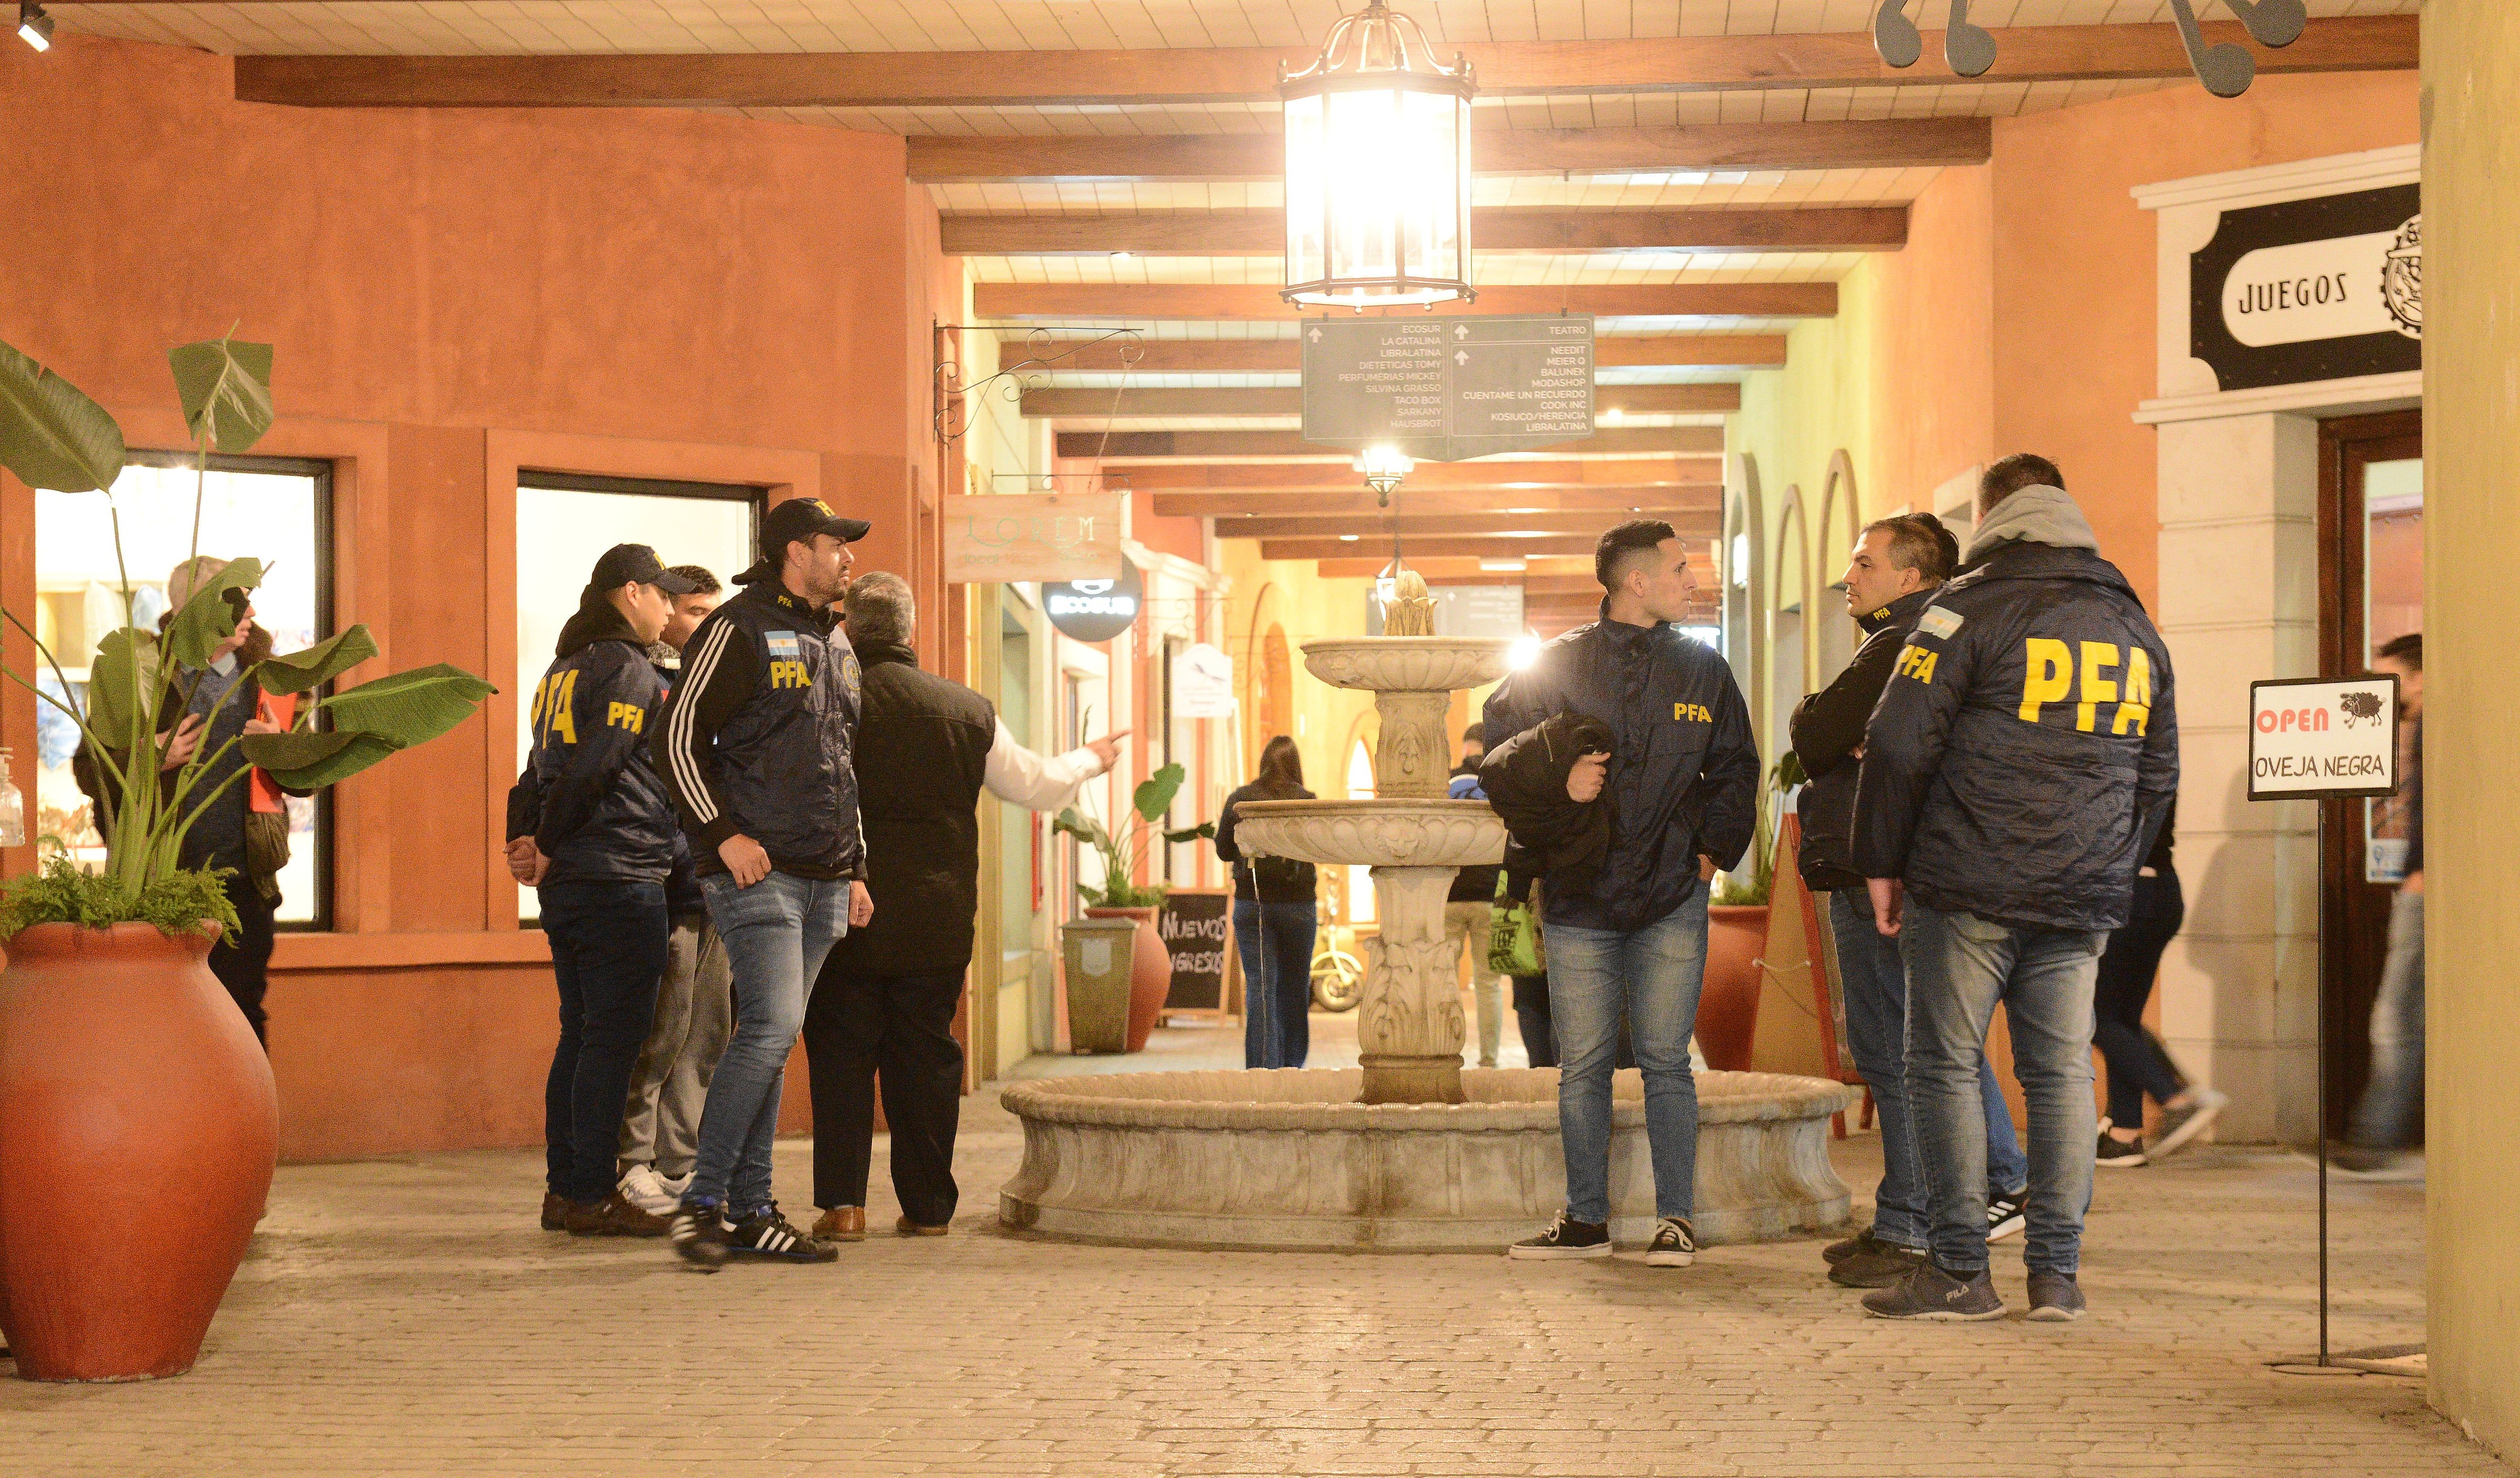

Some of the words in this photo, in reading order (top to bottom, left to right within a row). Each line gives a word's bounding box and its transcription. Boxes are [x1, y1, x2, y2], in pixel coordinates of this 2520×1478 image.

[2238, 273, 2349, 315] JUEGOS
[1403, 325, 1441, 333] ECOSUR
[1548, 326, 1587, 334] TEATRO
[1381, 337, 1394, 345] LA
[1396, 337, 1441, 345] CATALINA
[1380, 349, 1441, 357] LIBRALATINA
[1551, 346, 1586, 354] NEEDIT
[1360, 361, 1413, 369] DIETETICAS
[1546, 357, 1576, 365] MEIER
[1579, 357, 1586, 365] Q
[1339, 373, 1404, 381] PERFUMERIAS
[1407, 372, 1441, 380] MICKEY
[1541, 368, 1586, 377] BALUNEK
[1531, 379, 1586, 387] MODASHOP
[1366, 385, 1402, 393] SILVINA
[1404, 384, 1441, 392] GRASSO
[1463, 392, 1515, 400] CUENTAME
[1534, 390, 1587, 399] RECUERDO
[1395, 396, 1419, 404] TACO
[1541, 401, 1568, 409] COOK
[1569, 401, 1586, 409] INC
[1491, 412, 1587, 421] KOSIUCO/HERENCIA
[1391, 419, 1441, 427] HAUSBROT
[1526, 422, 1587, 431] LIBRALATINA
[967, 515, 1096, 549] LOREM
[778, 595, 793, 608] PFA
[1873, 607, 1891, 621] PFA
[1893, 645, 1939, 685] PFA
[770, 660, 813, 689] PFA
[2019, 638, 2152, 737] PFA
[1674, 702, 1713, 723] PFA
[607, 701, 645, 734] PFA
[2256, 707, 2328, 733] OPEN
[2255, 756, 2318, 778] OVEJA
[2324, 754, 2385, 777] NEGRA
[1162, 910, 1227, 941] NUEVOS
[1945, 1284, 1969, 1303] FILA
